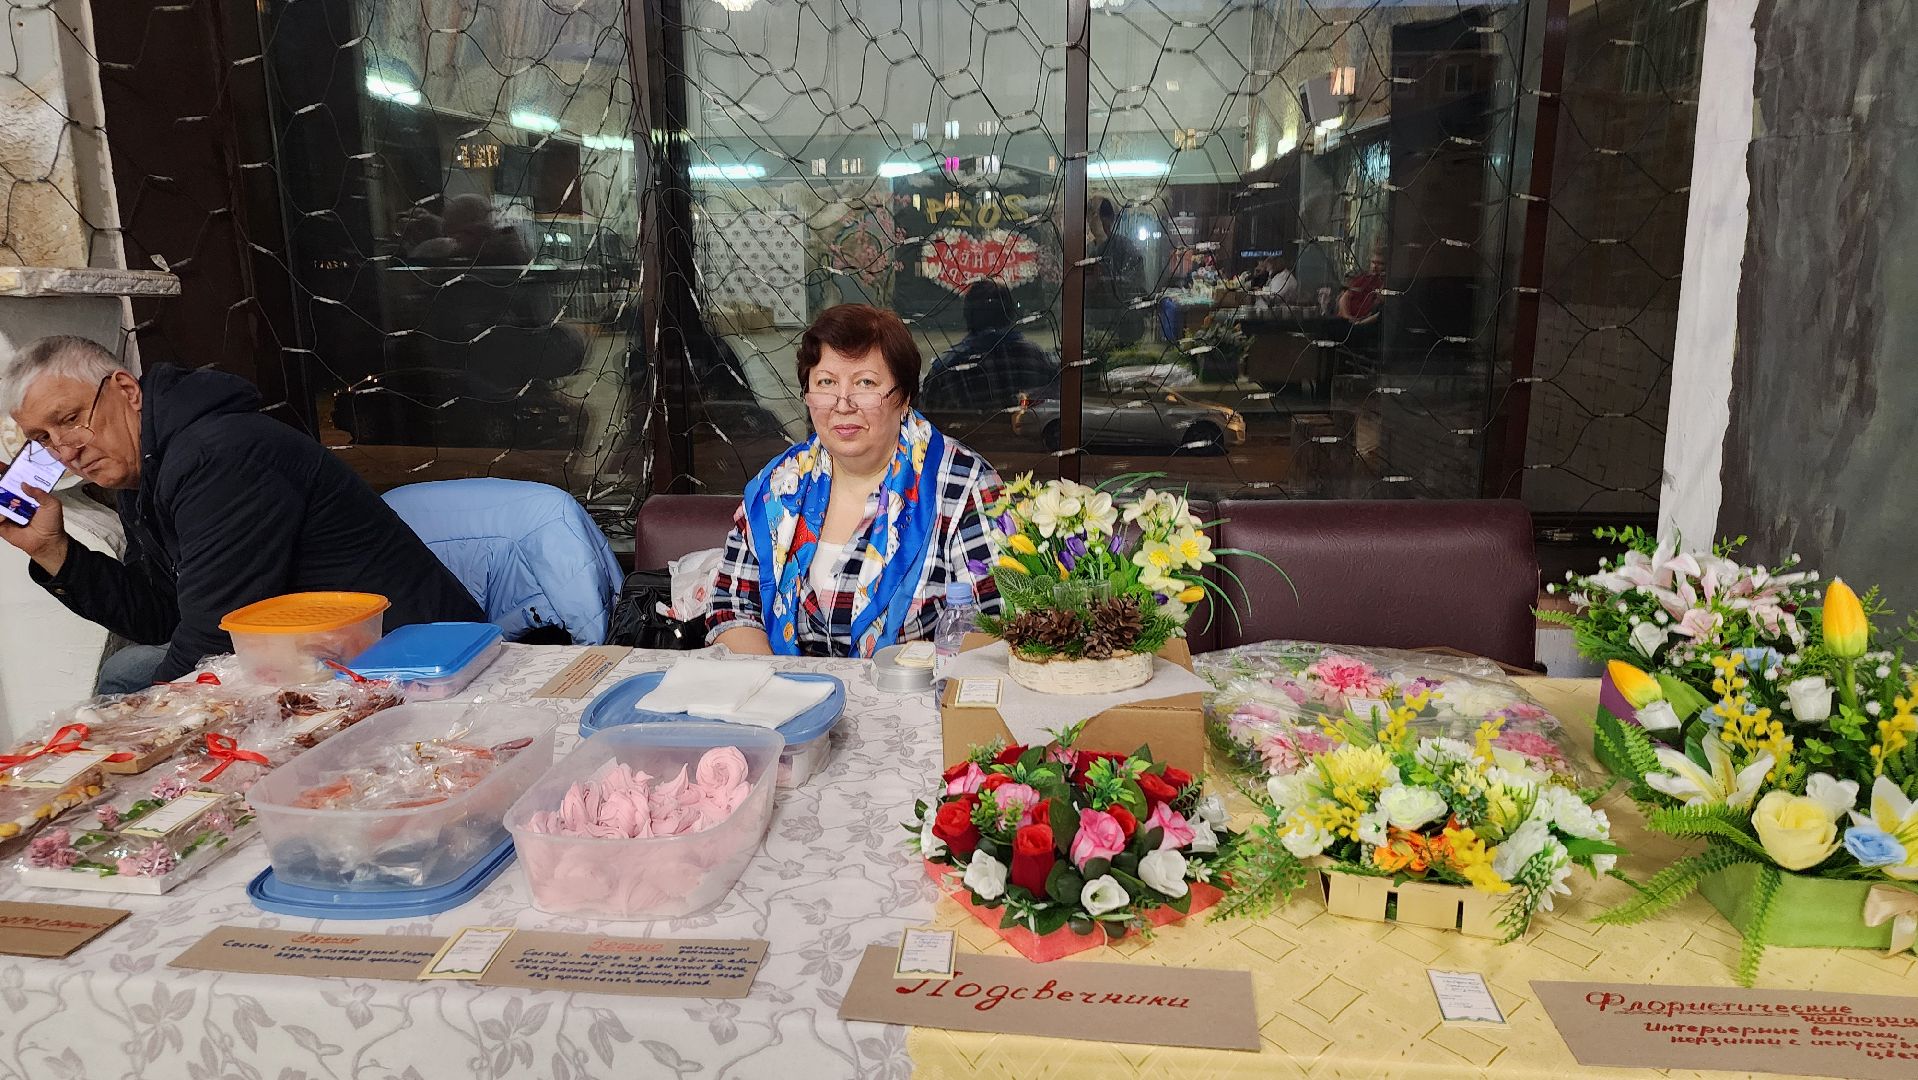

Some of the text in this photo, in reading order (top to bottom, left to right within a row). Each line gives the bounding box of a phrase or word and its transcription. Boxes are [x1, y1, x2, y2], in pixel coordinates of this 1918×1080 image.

[895, 969, 1191, 1012] Подсвечники
[1585, 991, 1853, 1018] Флористические
[1643, 1021, 1800, 1037] Интерьерные
[1670, 1035, 1781, 1047] корзинки
